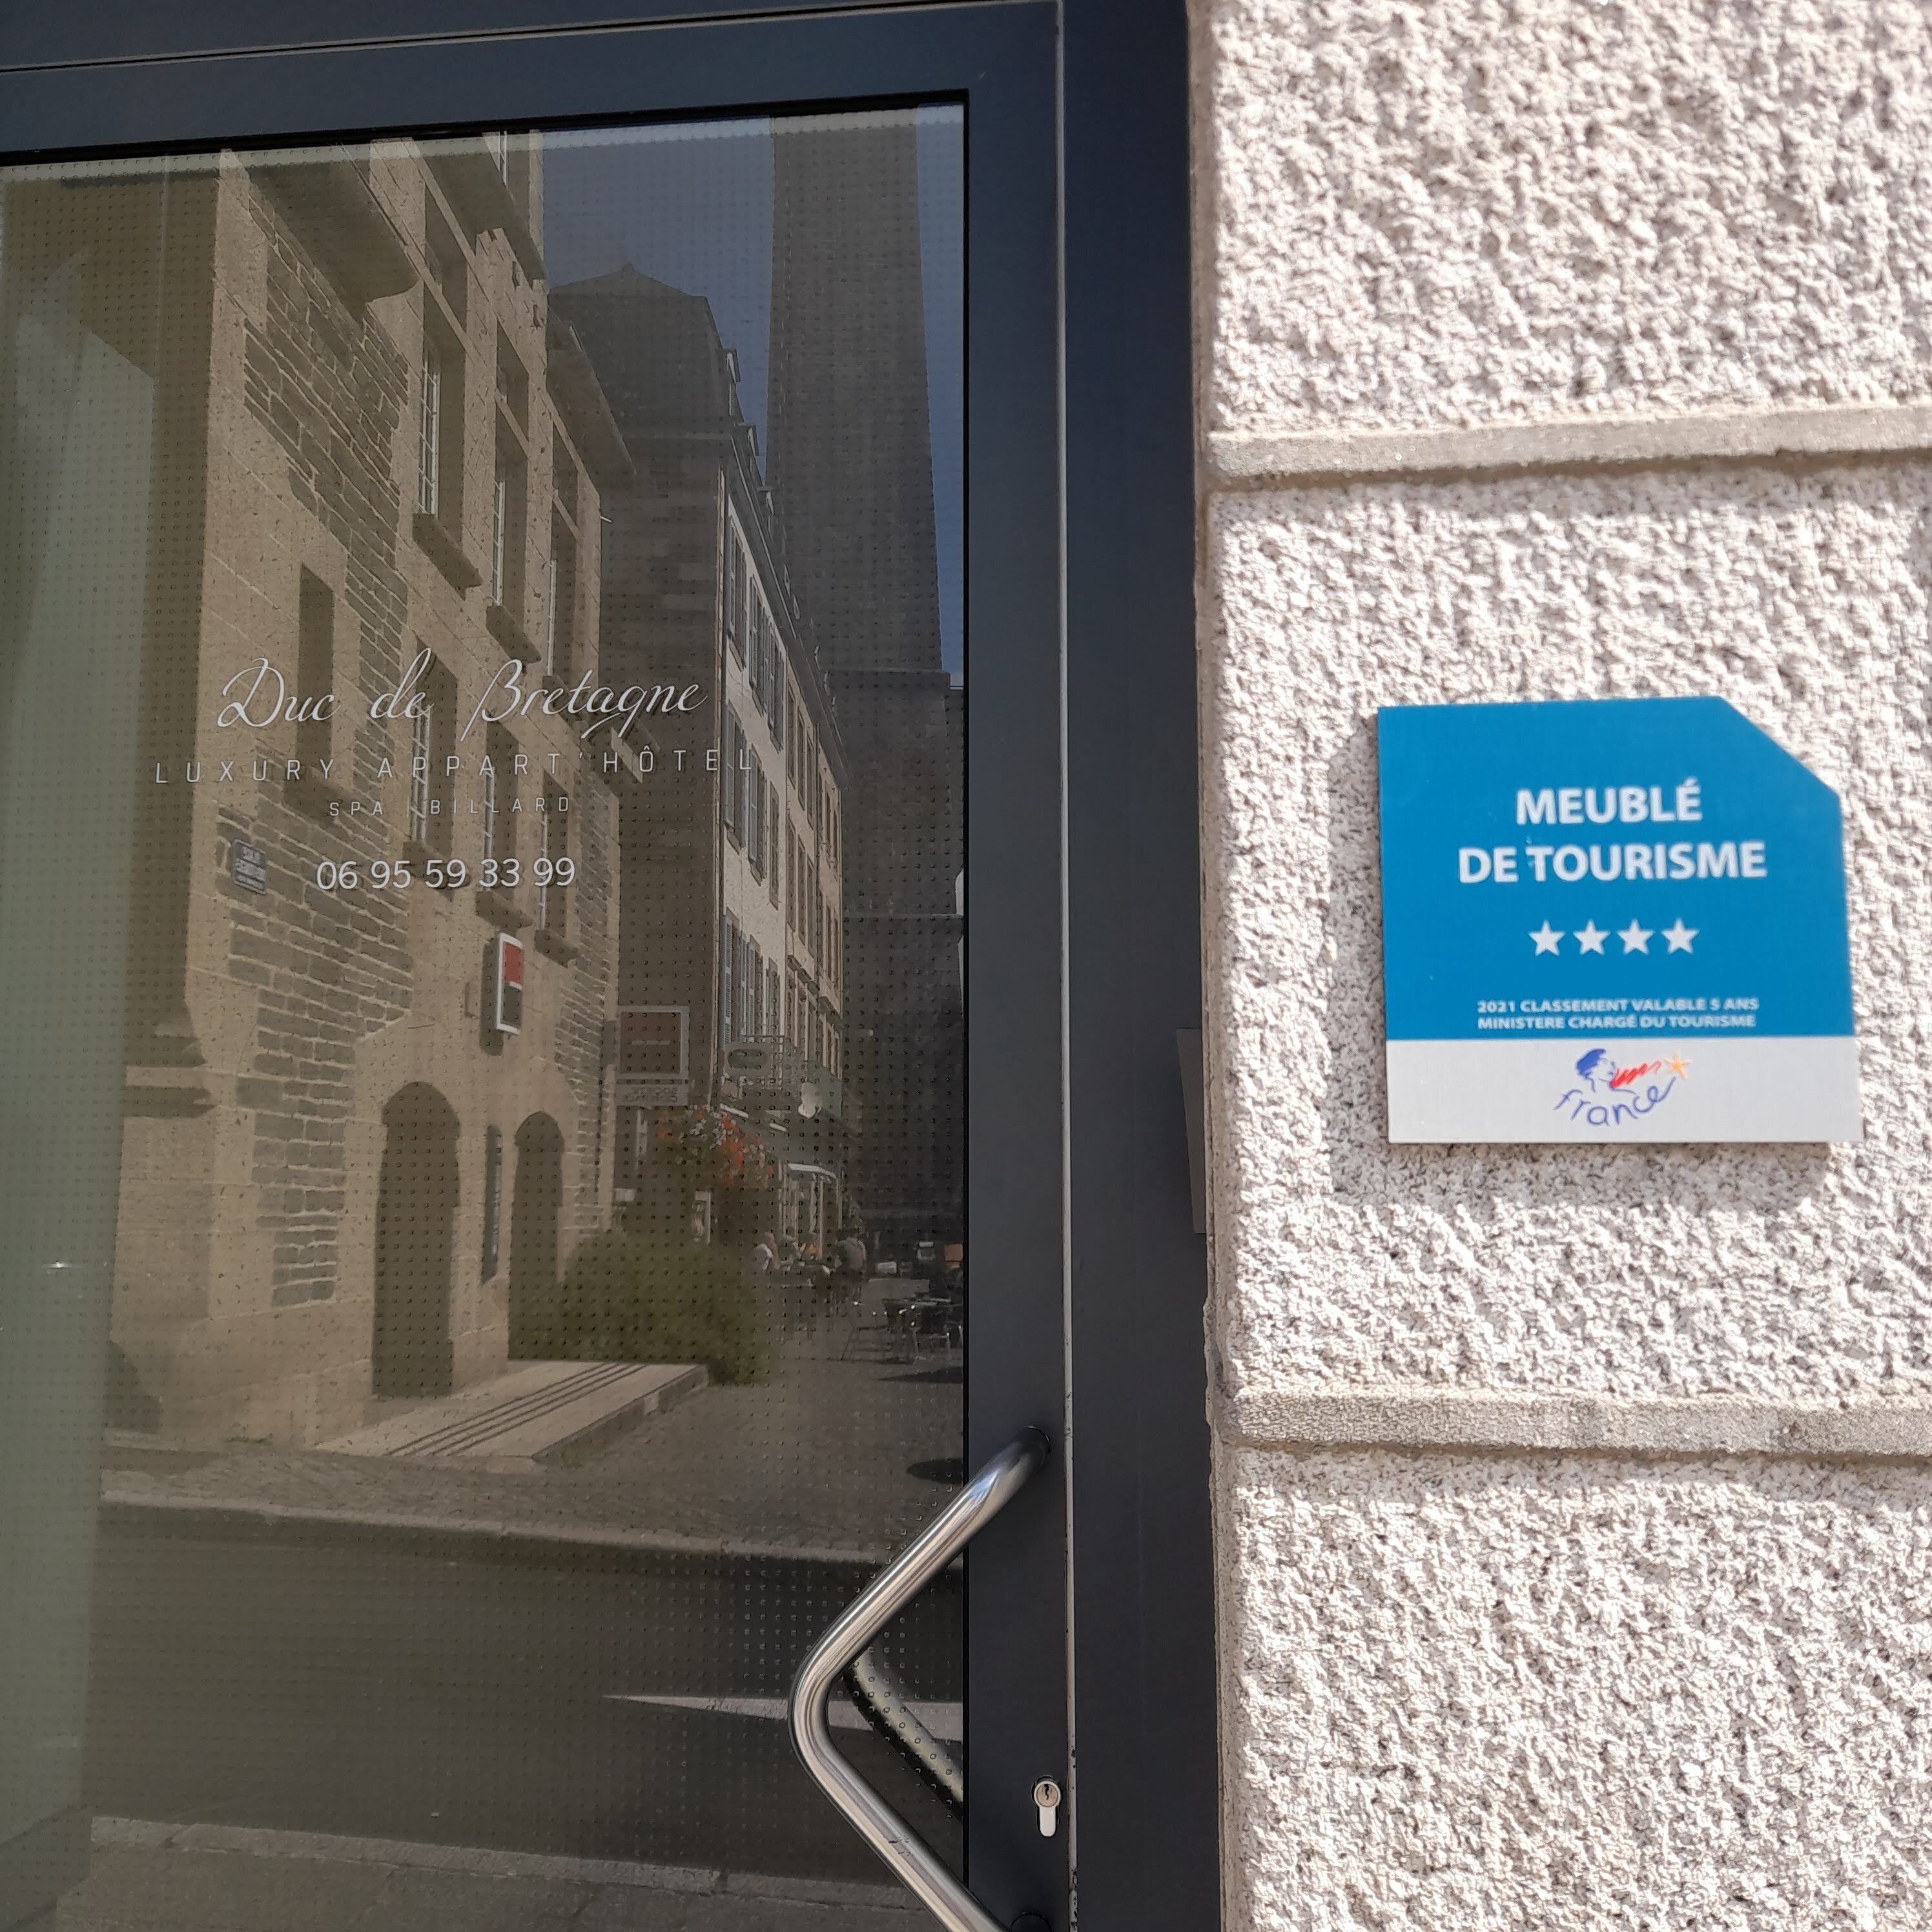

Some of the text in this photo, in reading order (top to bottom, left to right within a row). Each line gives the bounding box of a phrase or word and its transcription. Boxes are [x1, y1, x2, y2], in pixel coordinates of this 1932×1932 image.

[217, 648, 708, 742] Duc de Bretagne
[155, 759, 334, 783] LUXURY
[329, 797, 568, 816] SPA BILLARD
[1516, 777, 1703, 825] MEUBLÉ
[316, 858, 575, 890] 06 95 59 33 99
[1458, 841, 1768, 883] DE TOURISME
[1477, 998, 1760, 1014] 2021 CLASSEMENT VALABLE 5 ANS
[1477, 1014, 1757, 1030] MINISTERE CHARGÉ DU TOURISME
